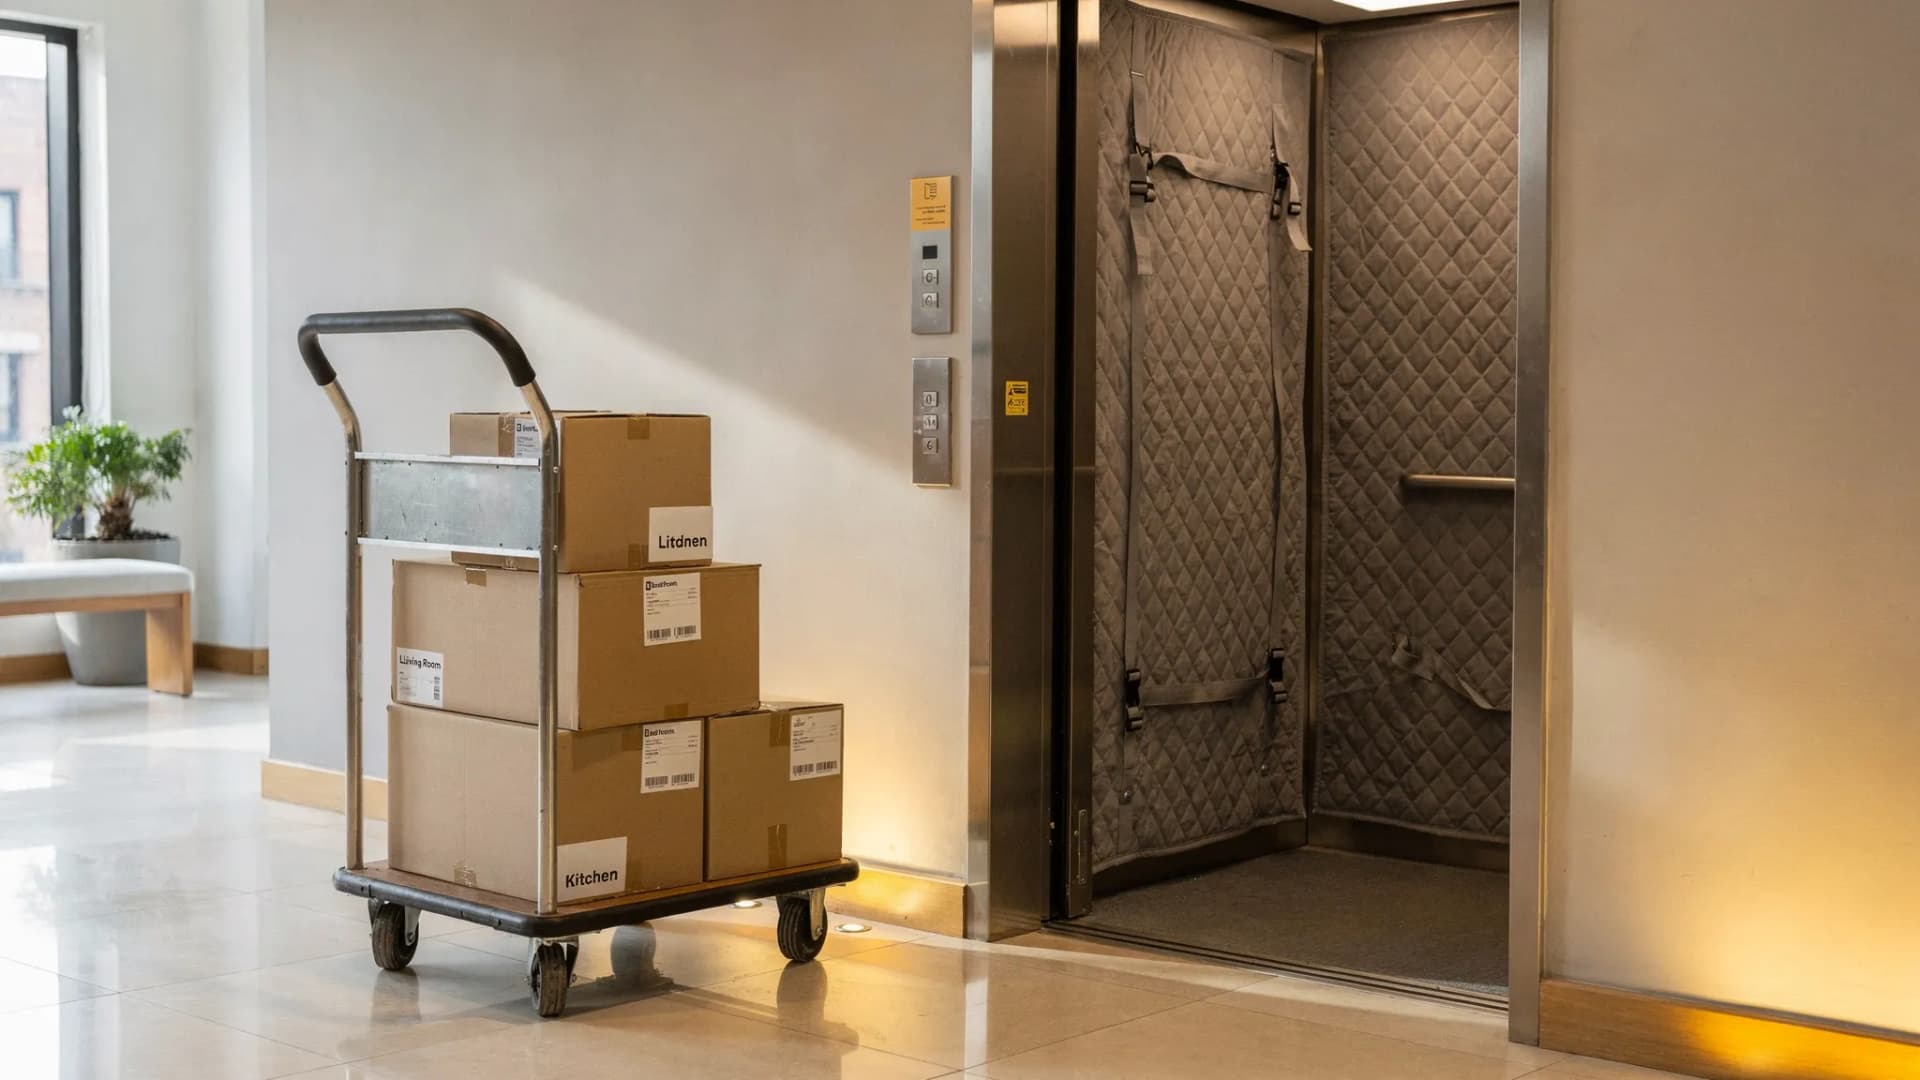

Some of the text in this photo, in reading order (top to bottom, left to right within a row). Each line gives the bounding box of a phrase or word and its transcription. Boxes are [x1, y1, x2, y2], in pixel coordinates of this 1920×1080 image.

[658, 534, 708, 549] Litdnen
[422, 658, 442, 669] Room
[565, 869, 618, 889] Kitchen
